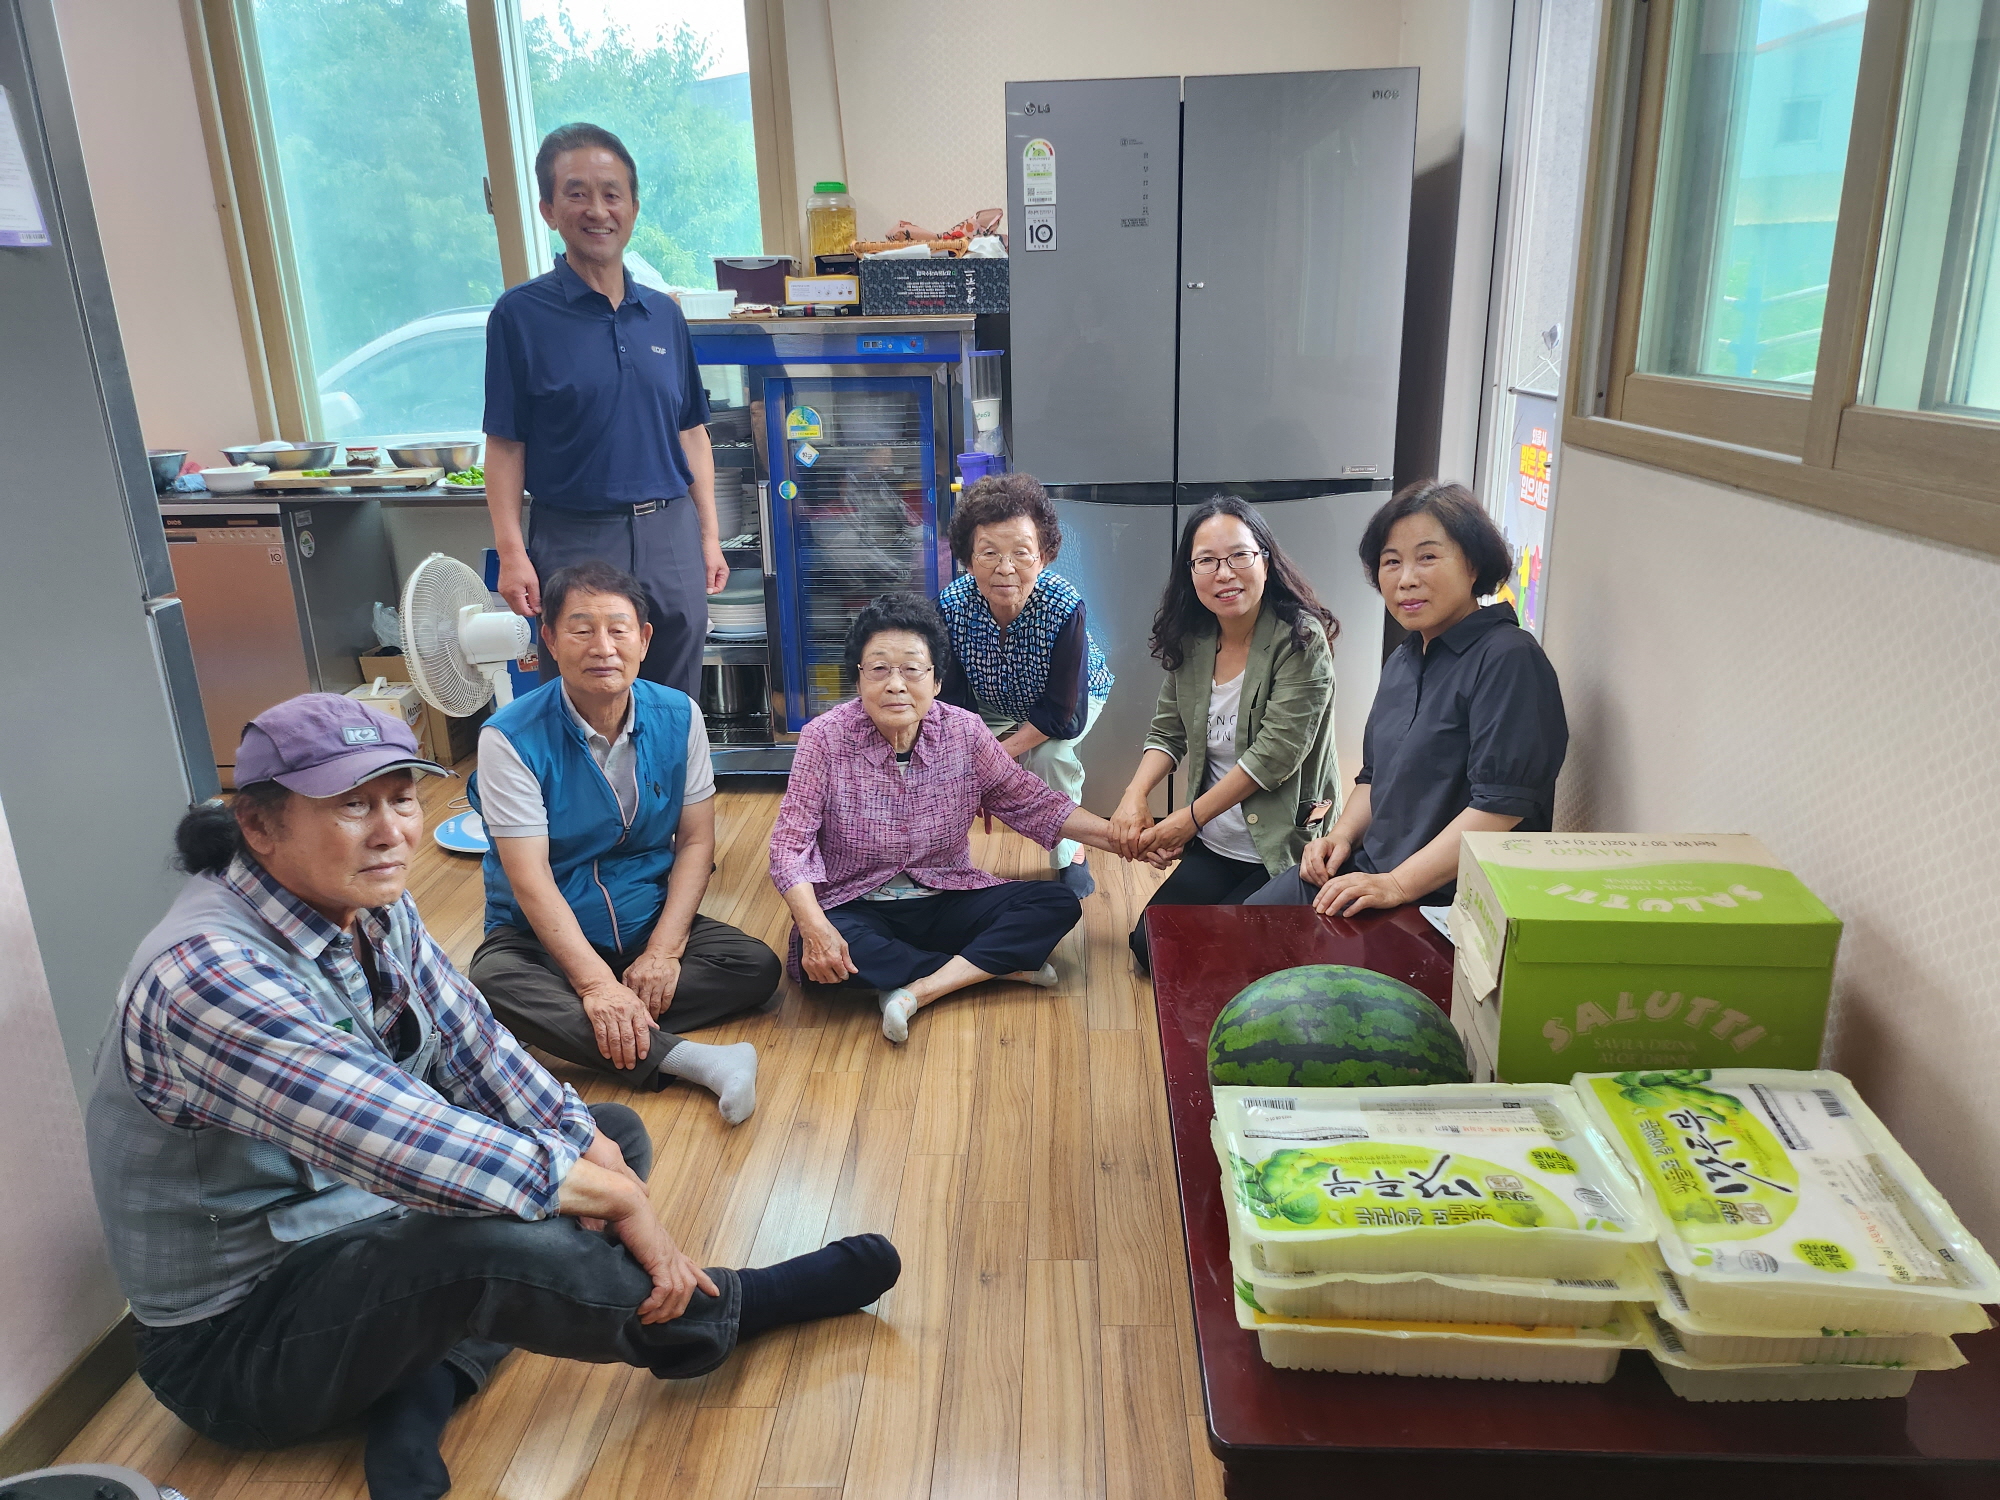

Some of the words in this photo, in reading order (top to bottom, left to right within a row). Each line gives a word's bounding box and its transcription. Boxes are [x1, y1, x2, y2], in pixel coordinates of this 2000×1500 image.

[1037, 103, 1051, 114] LG
[1028, 224, 1053, 244] 10
[1520, 444, 1536, 476] 밝은
[1520, 475, 1550, 508] 입으세요
[270, 553, 282, 562] 10
[348, 729, 377, 743] K2
[1551, 847, 1633, 857] MANGO
[1544, 882, 1764, 913] SALUTTI
[1542, 990, 1768, 1054] SALUTTI
[1649, 1040, 1698, 1052] DRINK
[1598, 1052, 1638, 1065] ALOE
[1640, 1053, 1690, 1066] DRINK
[1638, 1118, 1676, 1158] 갈아만든
[1531, 1150, 1570, 1162] 찌개용
[1537, 1160, 1576, 1172] 부드러운
[1354, 1206, 1425, 1226] 갈아만든
[1799, 1243, 1825, 1268] 부드러운
